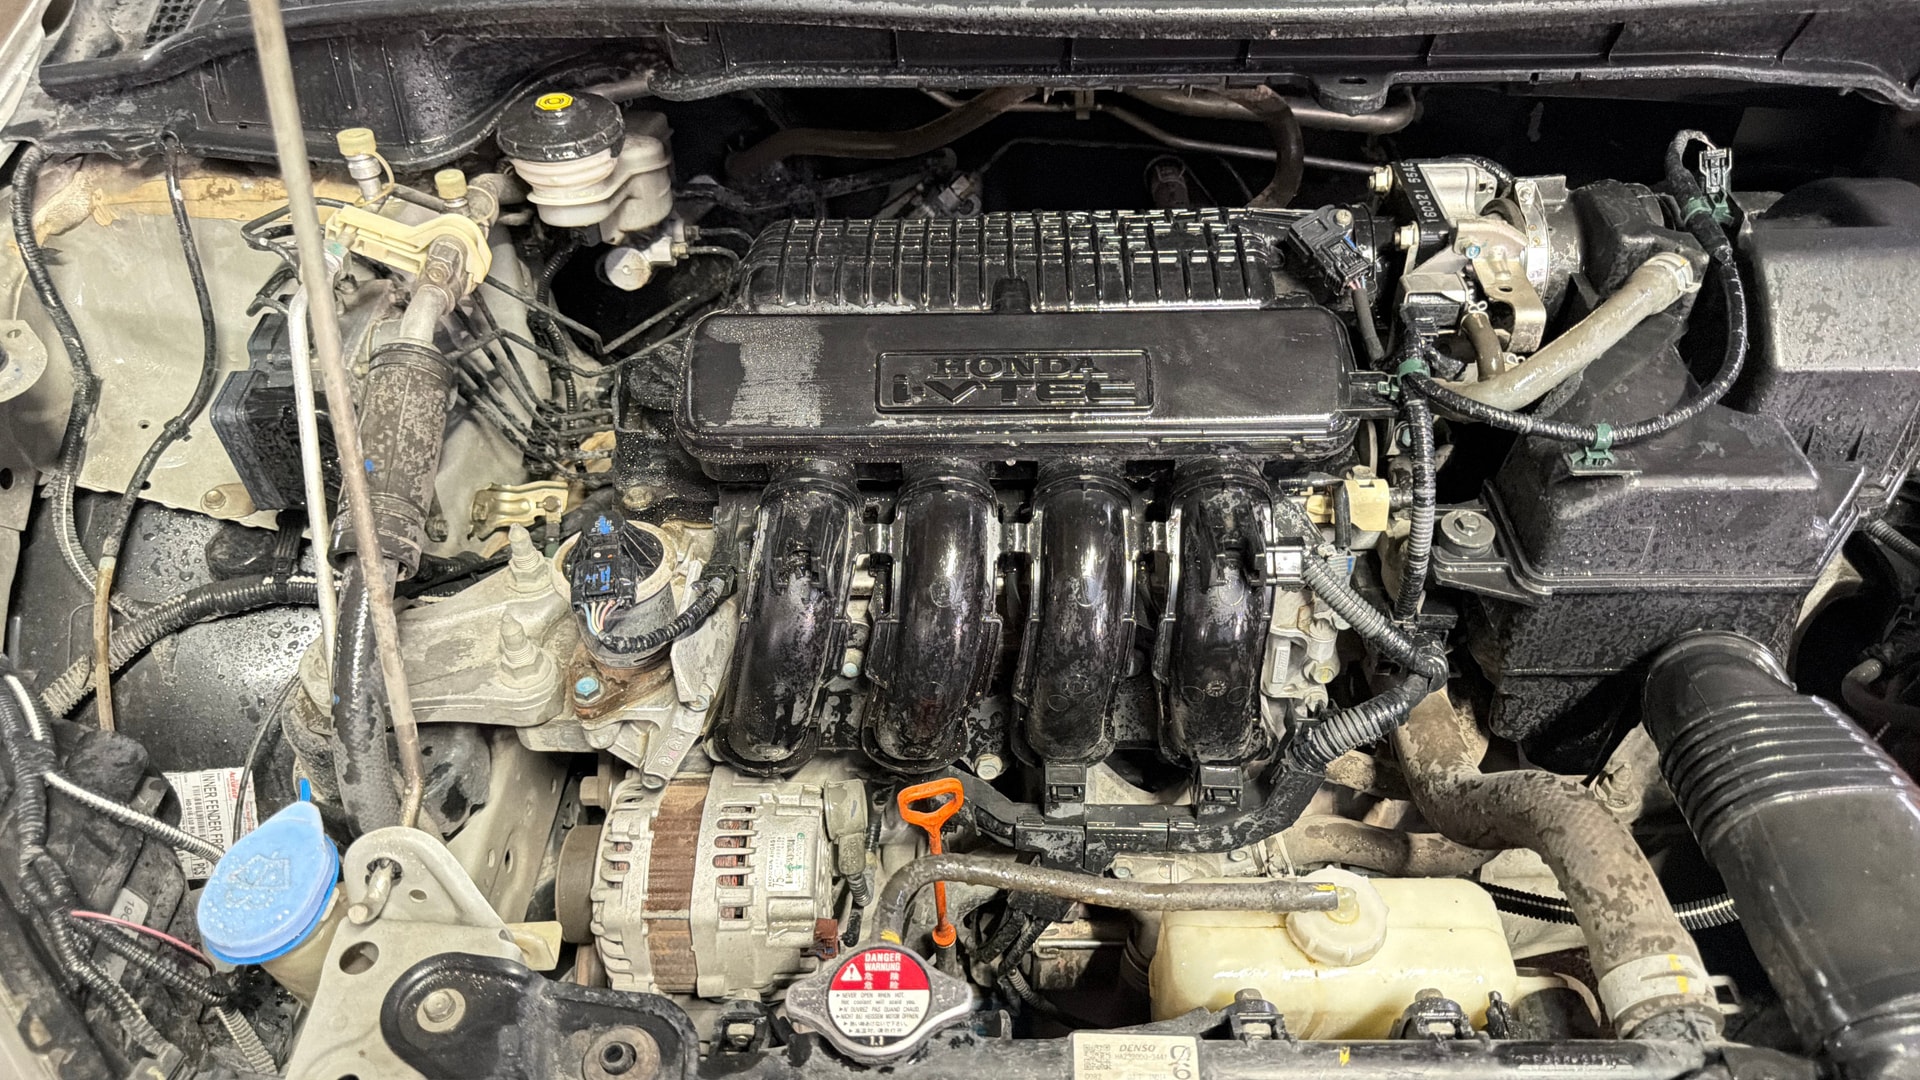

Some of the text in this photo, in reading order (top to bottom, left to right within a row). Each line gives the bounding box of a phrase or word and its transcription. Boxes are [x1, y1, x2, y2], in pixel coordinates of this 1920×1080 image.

[1400, 162, 1440, 223] 160321 55AE
[933, 357, 1109, 379] HONDA
[893, 373, 1136, 405] i-VTEC
[202, 773, 217, 800] INNER
[206, 799, 222, 832] FENDER
[193, 862, 206, 876] PCS
[864, 953, 901, 962] DANGER
[864, 962, 901, 971] WARNUNG
[1119, 1044, 1156, 1052] DENSO
